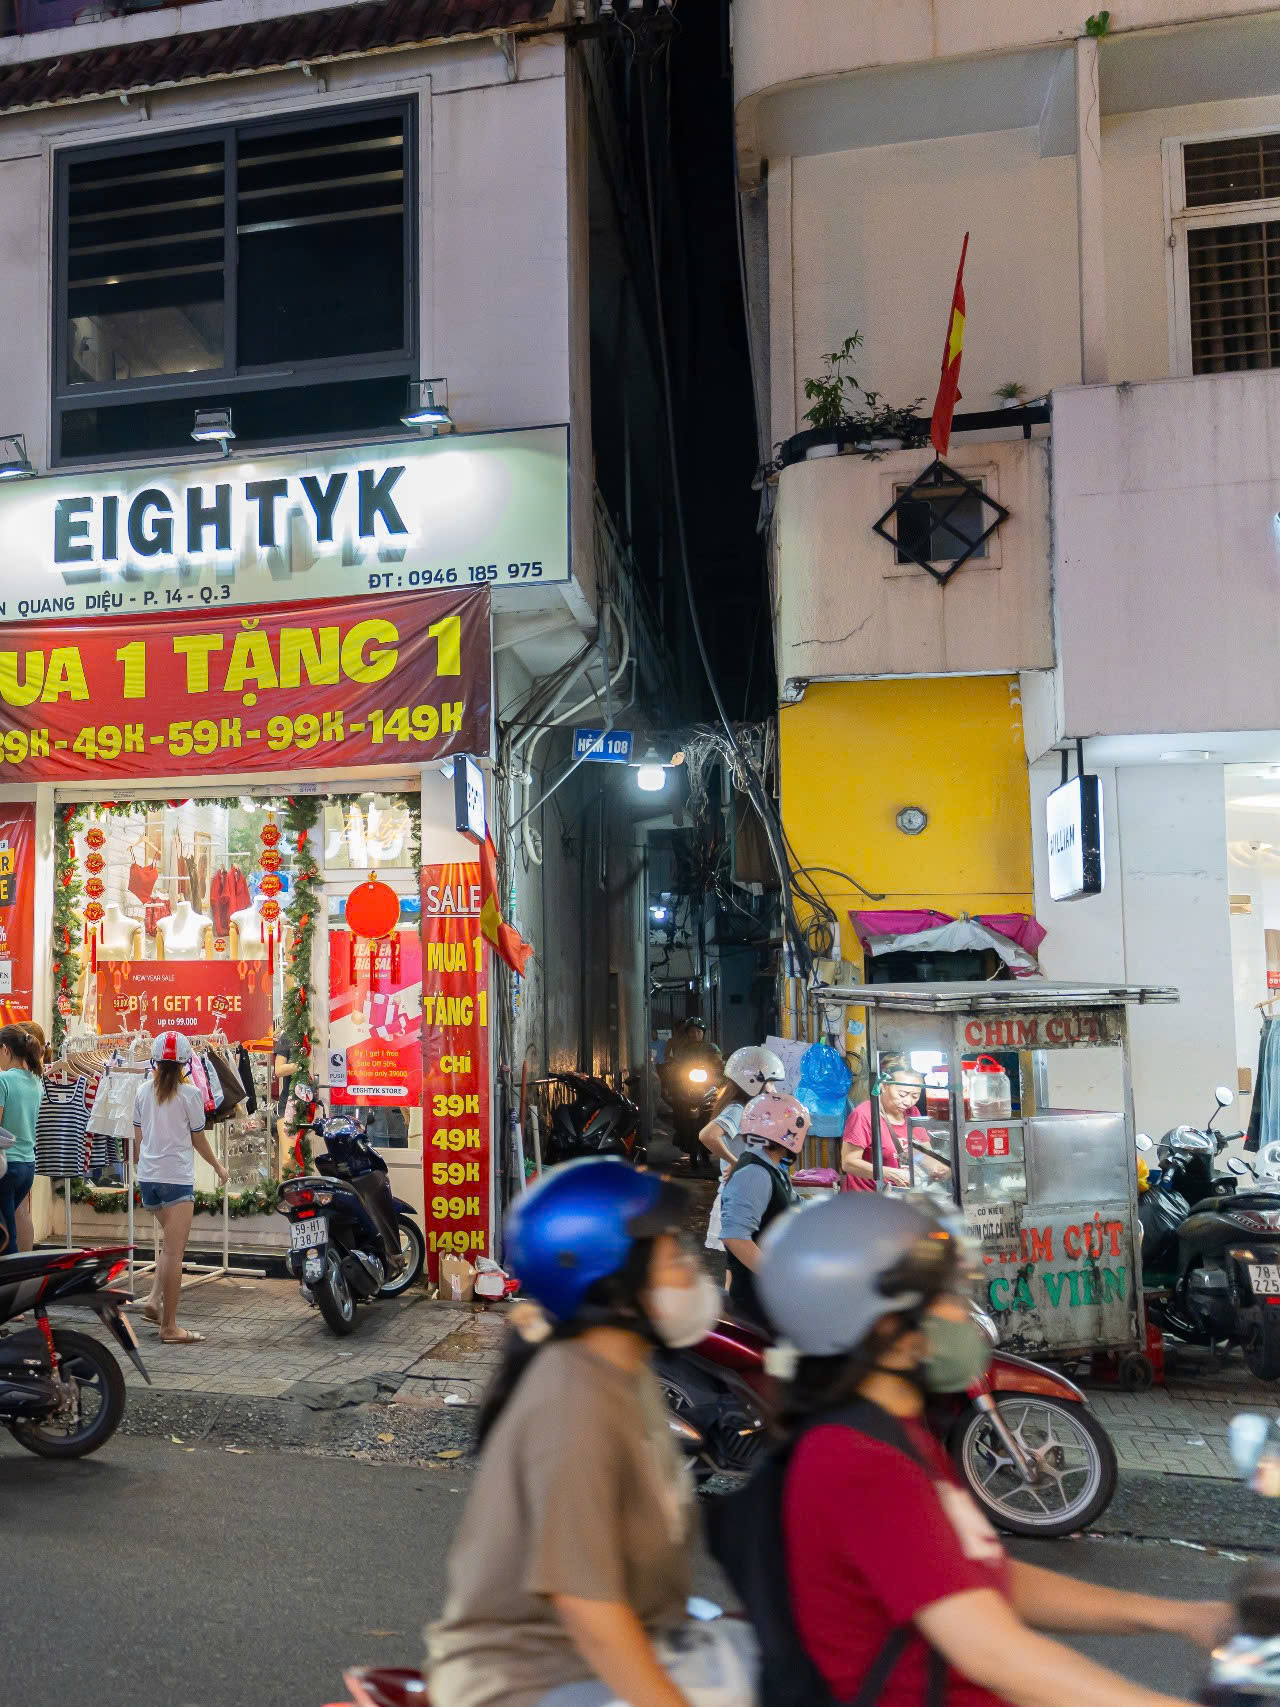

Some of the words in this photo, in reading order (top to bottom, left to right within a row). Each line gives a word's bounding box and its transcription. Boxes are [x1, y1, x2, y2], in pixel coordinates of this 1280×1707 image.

[54, 465, 409, 565] EIGHTYK
[408, 568, 458, 586] 0946
[468, 565, 497, 582] 185
[507, 562, 543, 578] 975
[19, 597, 75, 617] QUANG
[85, 590, 123, 612] DIỆU
[165, 589, 182, 603] 14
[117, 641, 148, 699] 1
[173, 618, 399, 707] TẶNG
[429, 616, 462, 677] 1
[607, 740, 629, 754] 108
[426, 884, 481, 913] SALE
[427, 943, 468, 973] MUA
[472, 936, 483, 973] 1
[152, 996, 159, 1011] 1
[163, 995, 191, 1011] GET
[195, 995, 201, 1011] 1
[423, 990, 473, 1033] TẶNG
[477, 990, 488, 1027] 1
[157, 1018, 167, 1027] up
[167, 1018, 175, 1026] to
[176, 1017, 198, 1026] 99.000
[965, 1018, 1039, 1046] CHIM
[432, 1094, 480, 1117] 39K
[432, 1128, 480, 1152] 49K
[432, 1162, 480, 1185] 59K
[432, 1196, 480, 1220] 99K
[428, 1230, 485, 1253] 149K
[1063, 1212, 1124, 1260] CÚT
[1041, 1259, 1126, 1309] VIÊN
